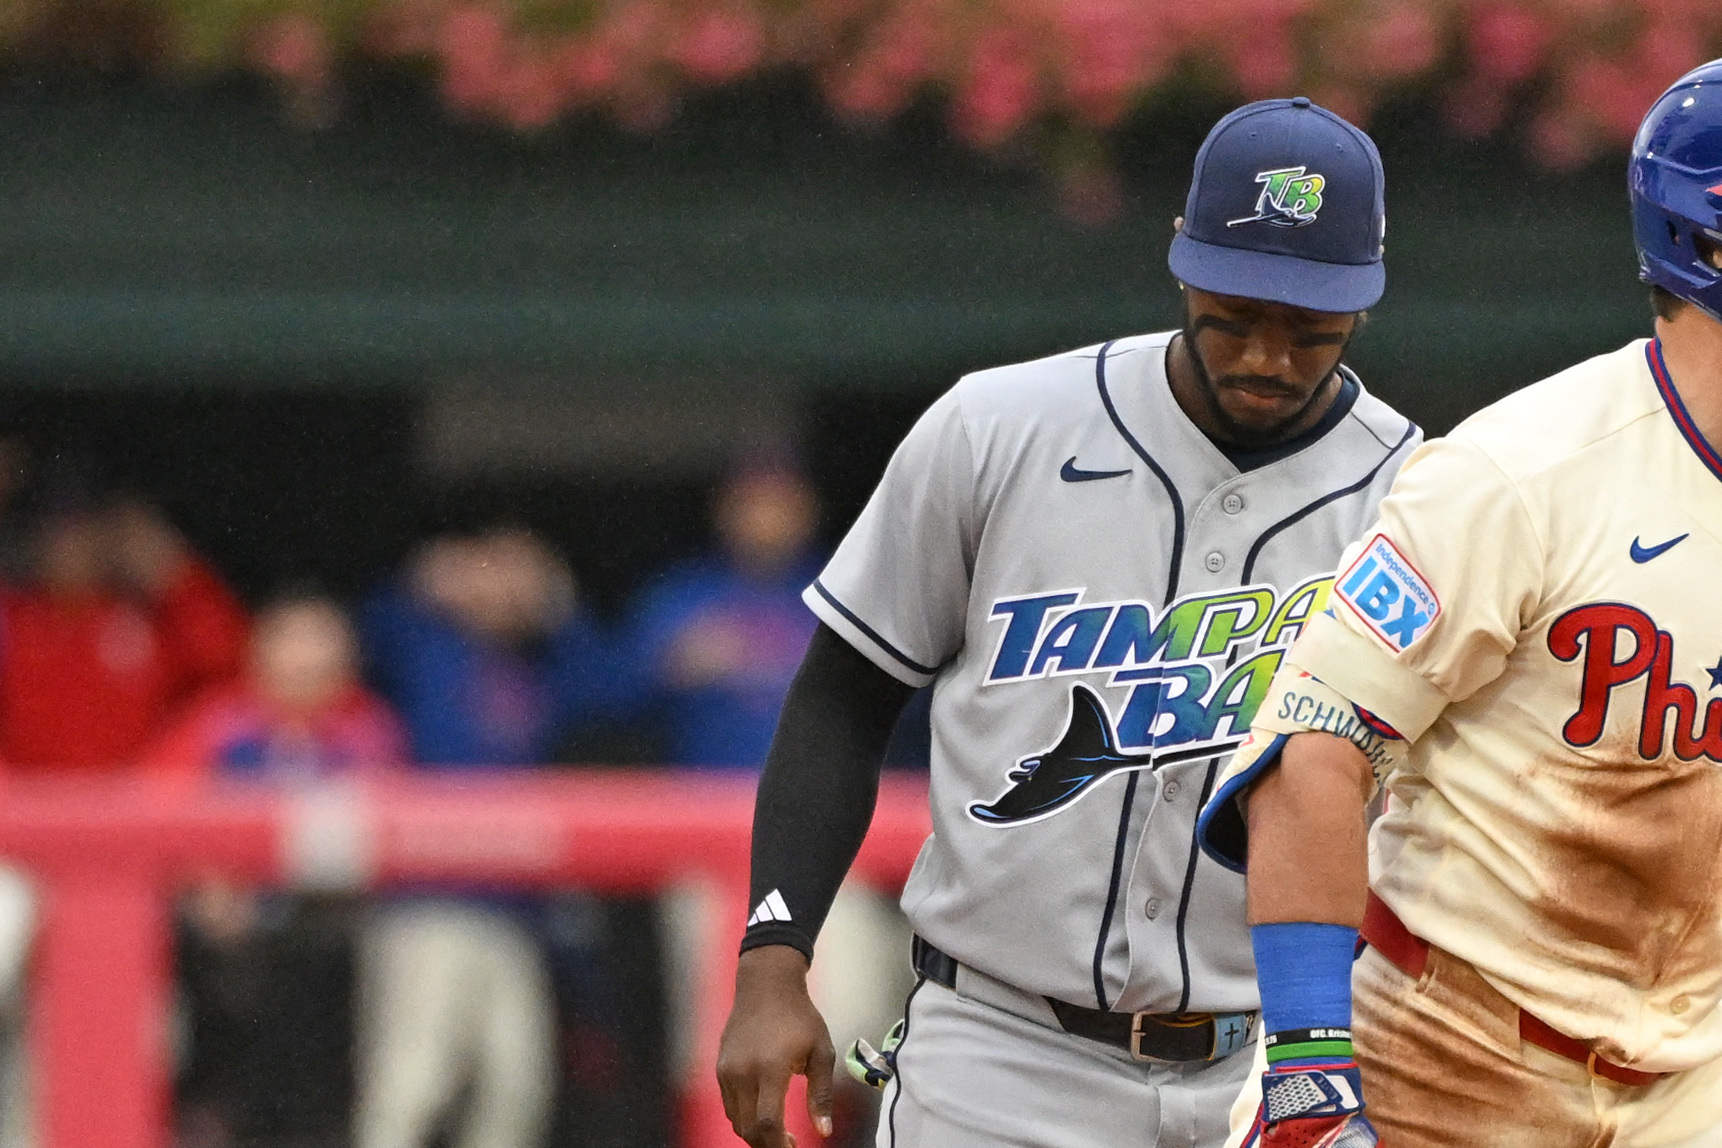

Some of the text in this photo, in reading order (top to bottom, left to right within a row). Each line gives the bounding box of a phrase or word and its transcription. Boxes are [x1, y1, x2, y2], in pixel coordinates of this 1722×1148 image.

[1342, 555, 1429, 649] IBX
[1375, 543, 1429, 604] Independence
[983, 571, 1336, 687] TAMPA
[1106, 649, 1288, 757] BA
